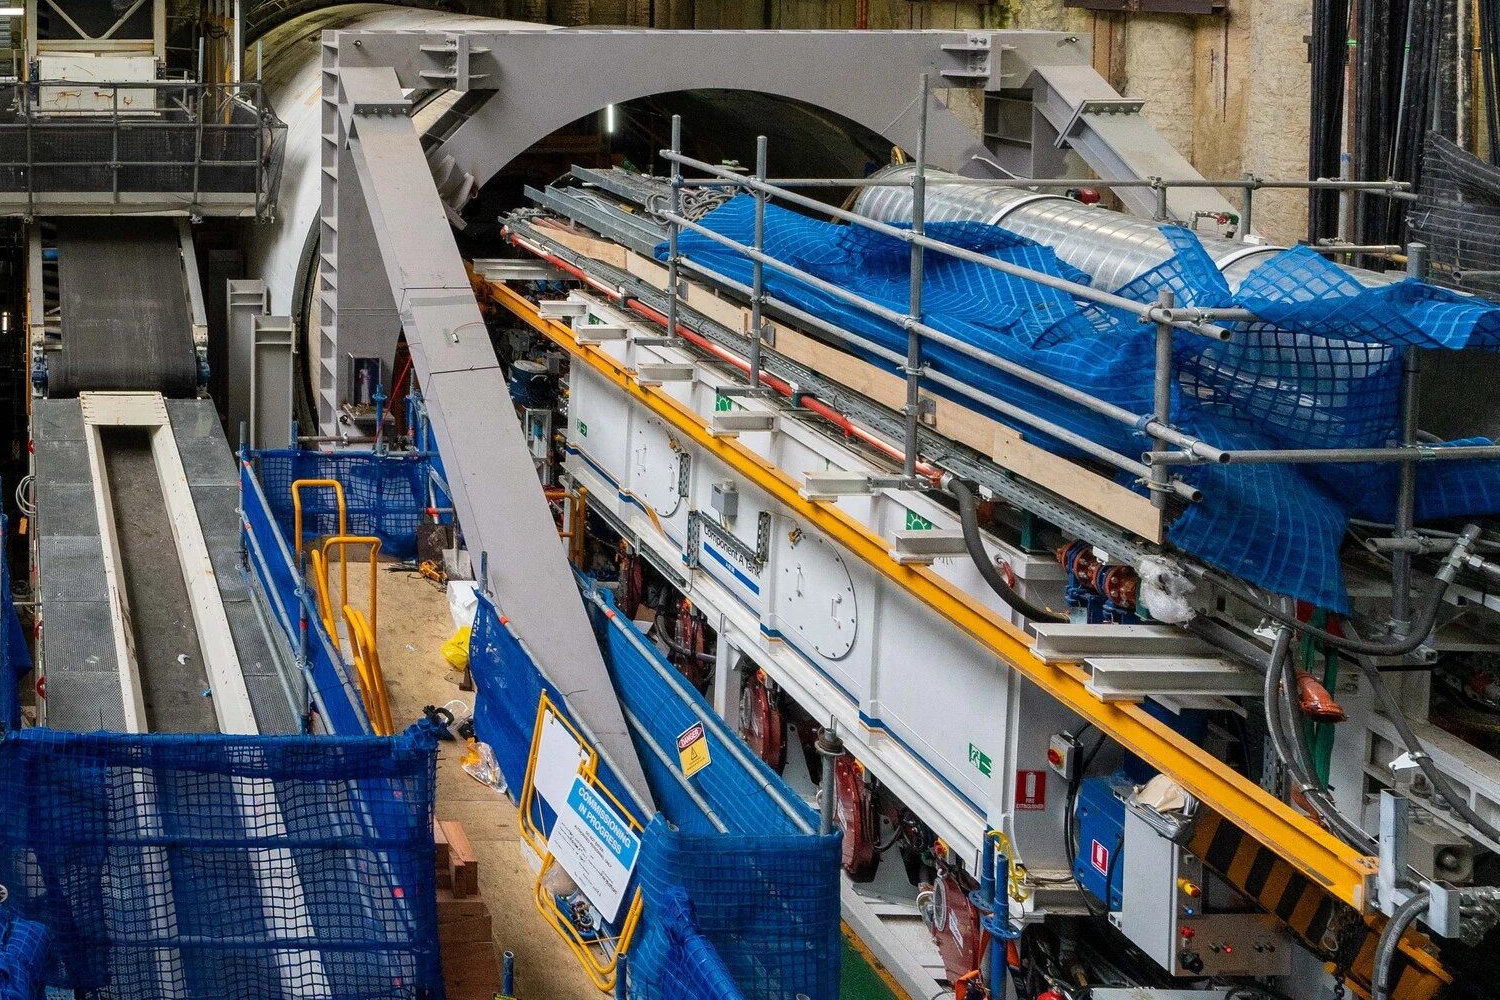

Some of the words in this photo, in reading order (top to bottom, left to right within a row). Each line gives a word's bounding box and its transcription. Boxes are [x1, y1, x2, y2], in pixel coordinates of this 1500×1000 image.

[738, 555, 745, 567] A
[578, 786, 631, 849] COMMISSIONING
[578, 803, 588, 816] IN
[585, 813, 622, 855] PROGRESS
